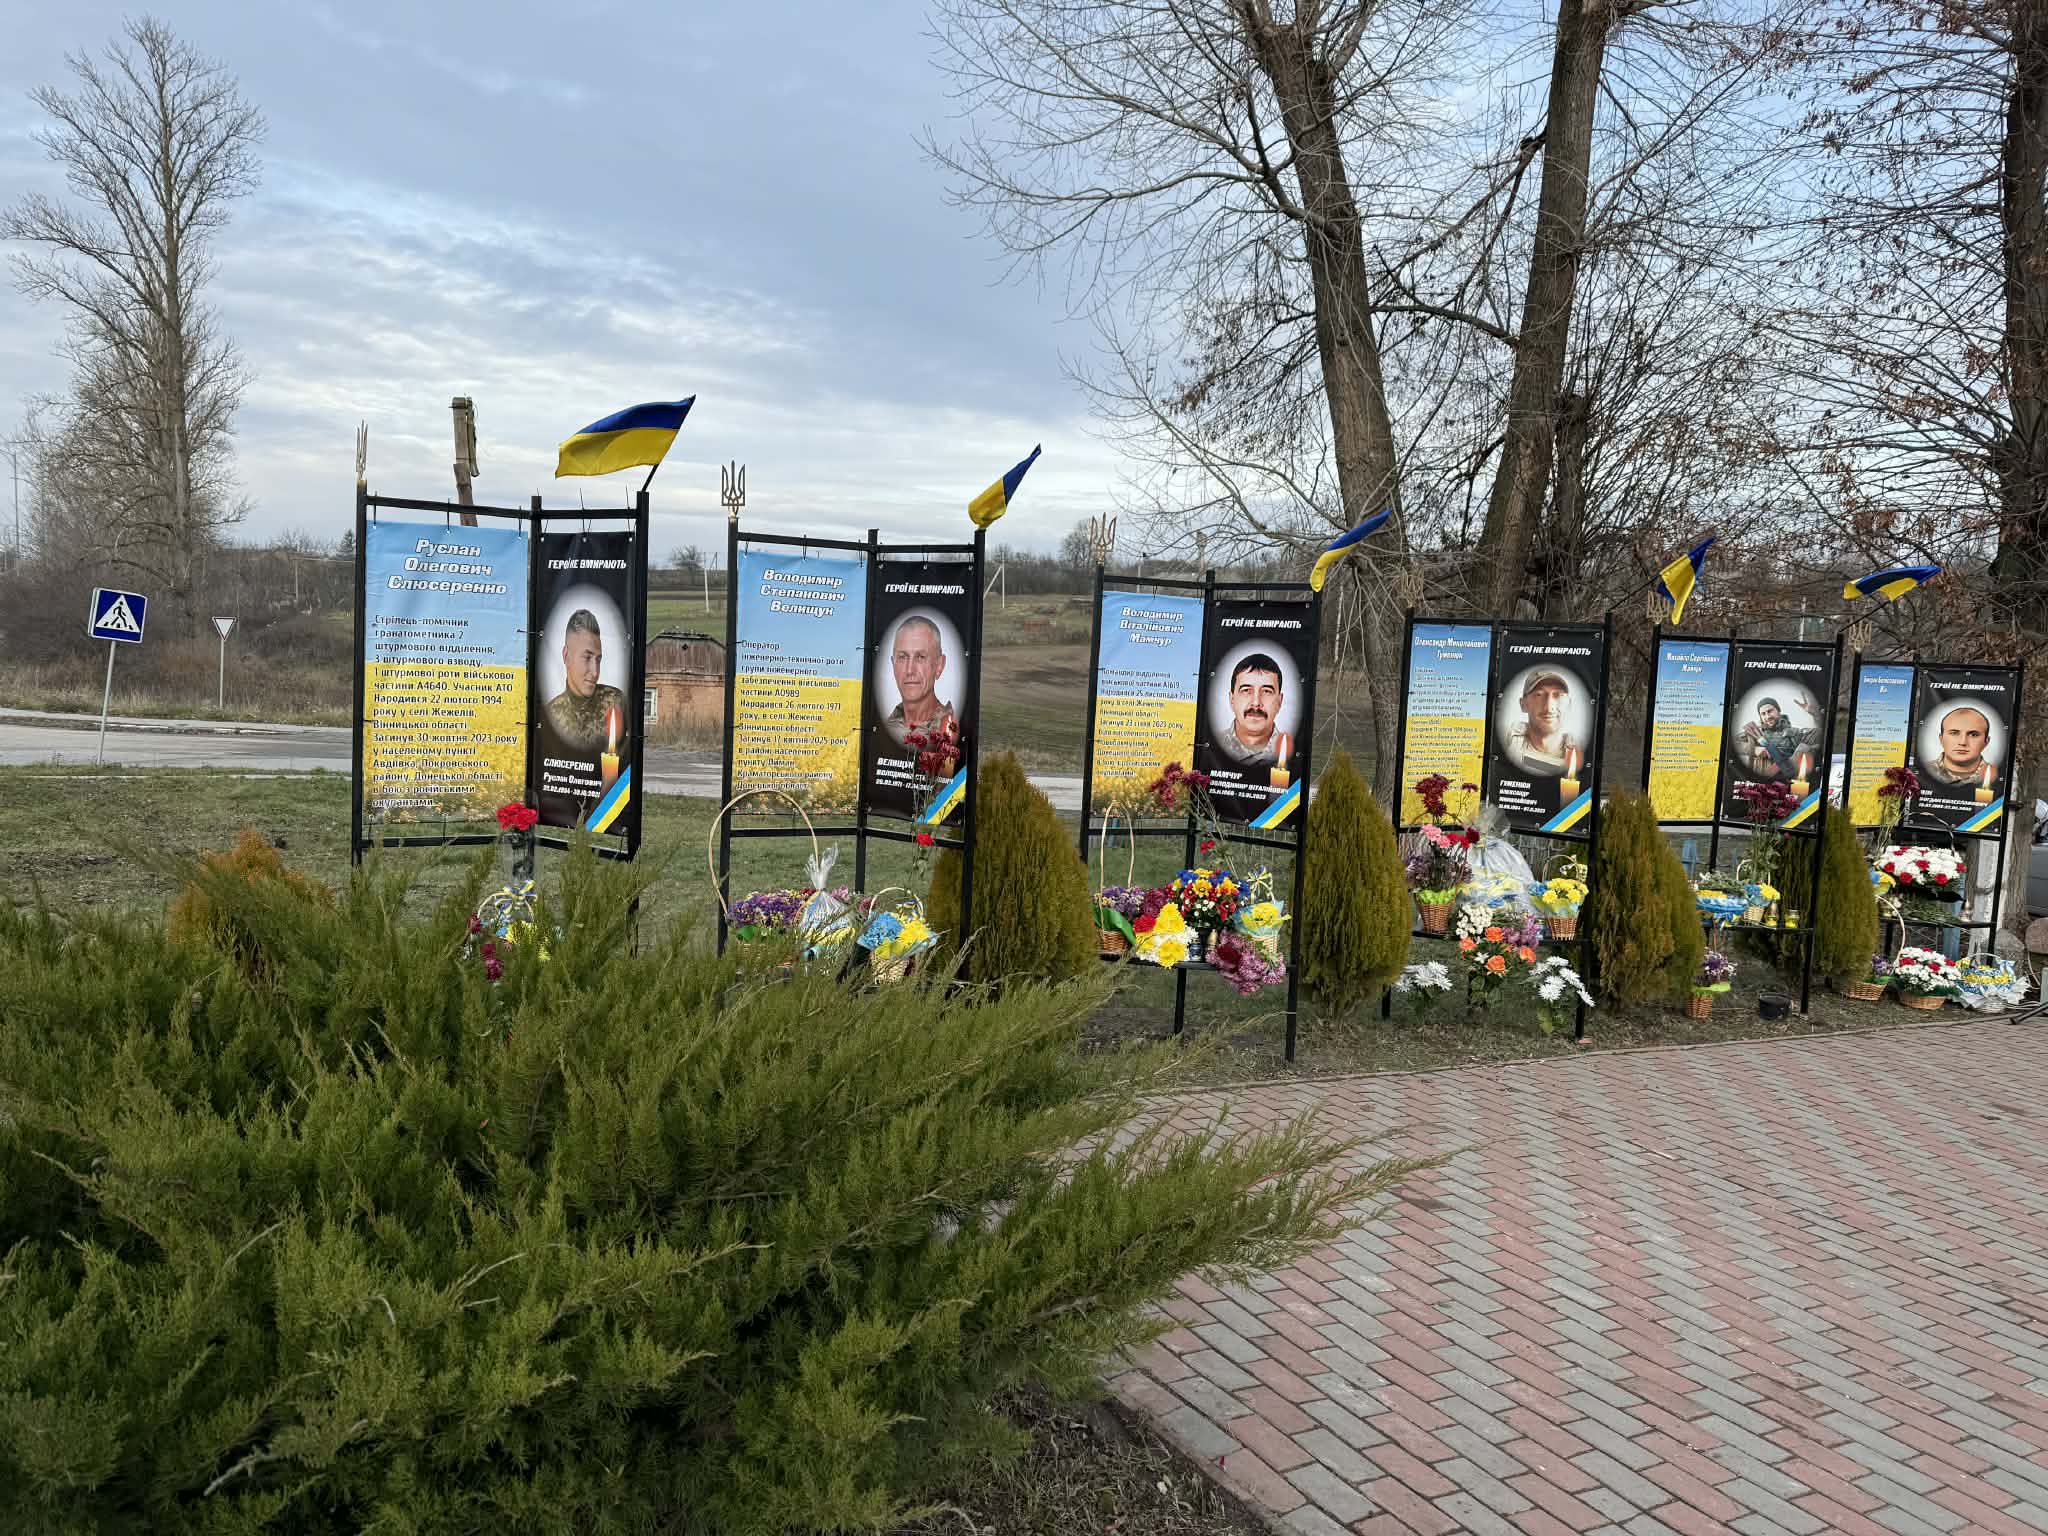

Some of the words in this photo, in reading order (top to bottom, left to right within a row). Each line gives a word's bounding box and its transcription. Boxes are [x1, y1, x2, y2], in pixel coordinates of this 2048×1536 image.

[415, 538, 481, 557] Руслан
[404, 556, 493, 576] Олегович
[579, 559, 627, 570] ВМИРАЮТЬ
[763, 569, 843, 589] Володимир
[760, 584, 845, 601] Степанович
[885, 582, 909, 593] ГЕРОЇ
[908, 584, 920, 593] НЕ
[920, 584, 965, 595] ВМИРАЮТЬ
[770, 600, 834, 617] Велищук
[1122, 606, 1184, 622] Володимир
[1120, 618, 1184, 634] Віталійович
[1256, 619, 1302, 629] ВМИРАЮТЬ
[742, 640, 780, 651] Оператор
[1129, 632, 1172, 647] Мамчур
[375, 643, 436, 653] штурмового
[1509, 645, 1533, 654] ГЕРОЇ
[1533, 646, 1545, 654] НЕ
[1545, 646, 1591, 656] ВМИРАЮТЬ
[383, 656, 444, 666] штурмового
[1744, 661, 1767, 669] ГЕРОЇ
[1778, 662, 1822, 672] ВМИРАЮТЬ
[382, 668, 435, 678] штурмової
[438, 671, 460, 679] роти
[463, 671, 515, 681] військової
[374, 682, 414, 691] частини
[453, 682, 493, 692] Учасник
[374, 693, 427, 705] Народився
[431, 694, 441, 704] 22
[481, 695, 502, 705] 1994
[741, 699, 783, 709] Народився
[373, 708, 397, 718] року
[409, 707, 428, 716] селі
[373, 719, 428, 730] Вінницької
[431, 719, 467, 730] області
[373, 732, 413, 742] Загинув
[417, 733, 428, 742] 30
[471, 733, 492, 743] 2023
[495, 735, 518, 744] року
[382, 748, 442, 756] населеному
[543, 772, 568, 783] Руслан
[568, 775, 602, 787] Олегович
